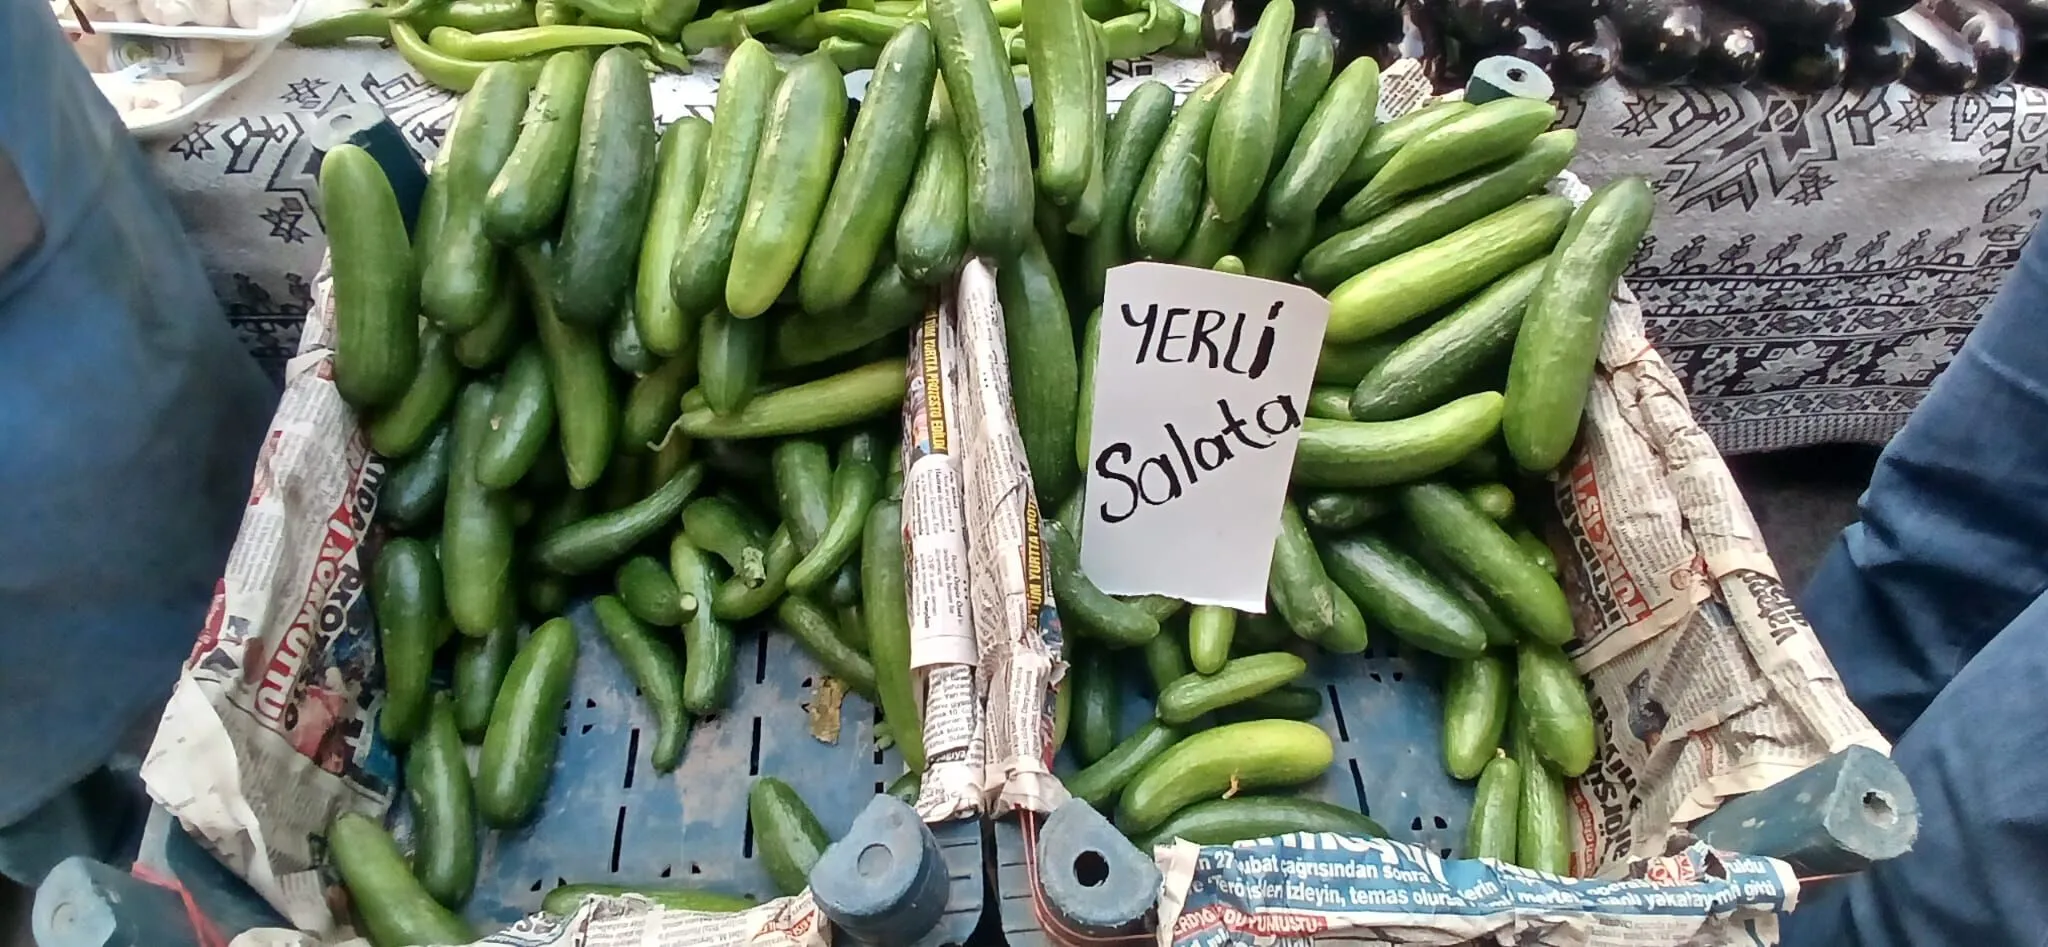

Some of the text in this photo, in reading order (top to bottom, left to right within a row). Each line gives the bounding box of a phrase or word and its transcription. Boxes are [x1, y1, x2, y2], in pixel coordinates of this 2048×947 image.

[1121, 301, 1284, 379] YERLİ
[1095, 394, 1301, 523] Salata
[1027, 536, 1042, 579] YURTTA
[1214, 851, 1235, 870] 27
[1281, 857, 1379, 880] çağrısından
[1383, 864, 1434, 884] sonra
[1350, 887, 1409, 905] temas
[1744, 880, 1777, 901] gitti
